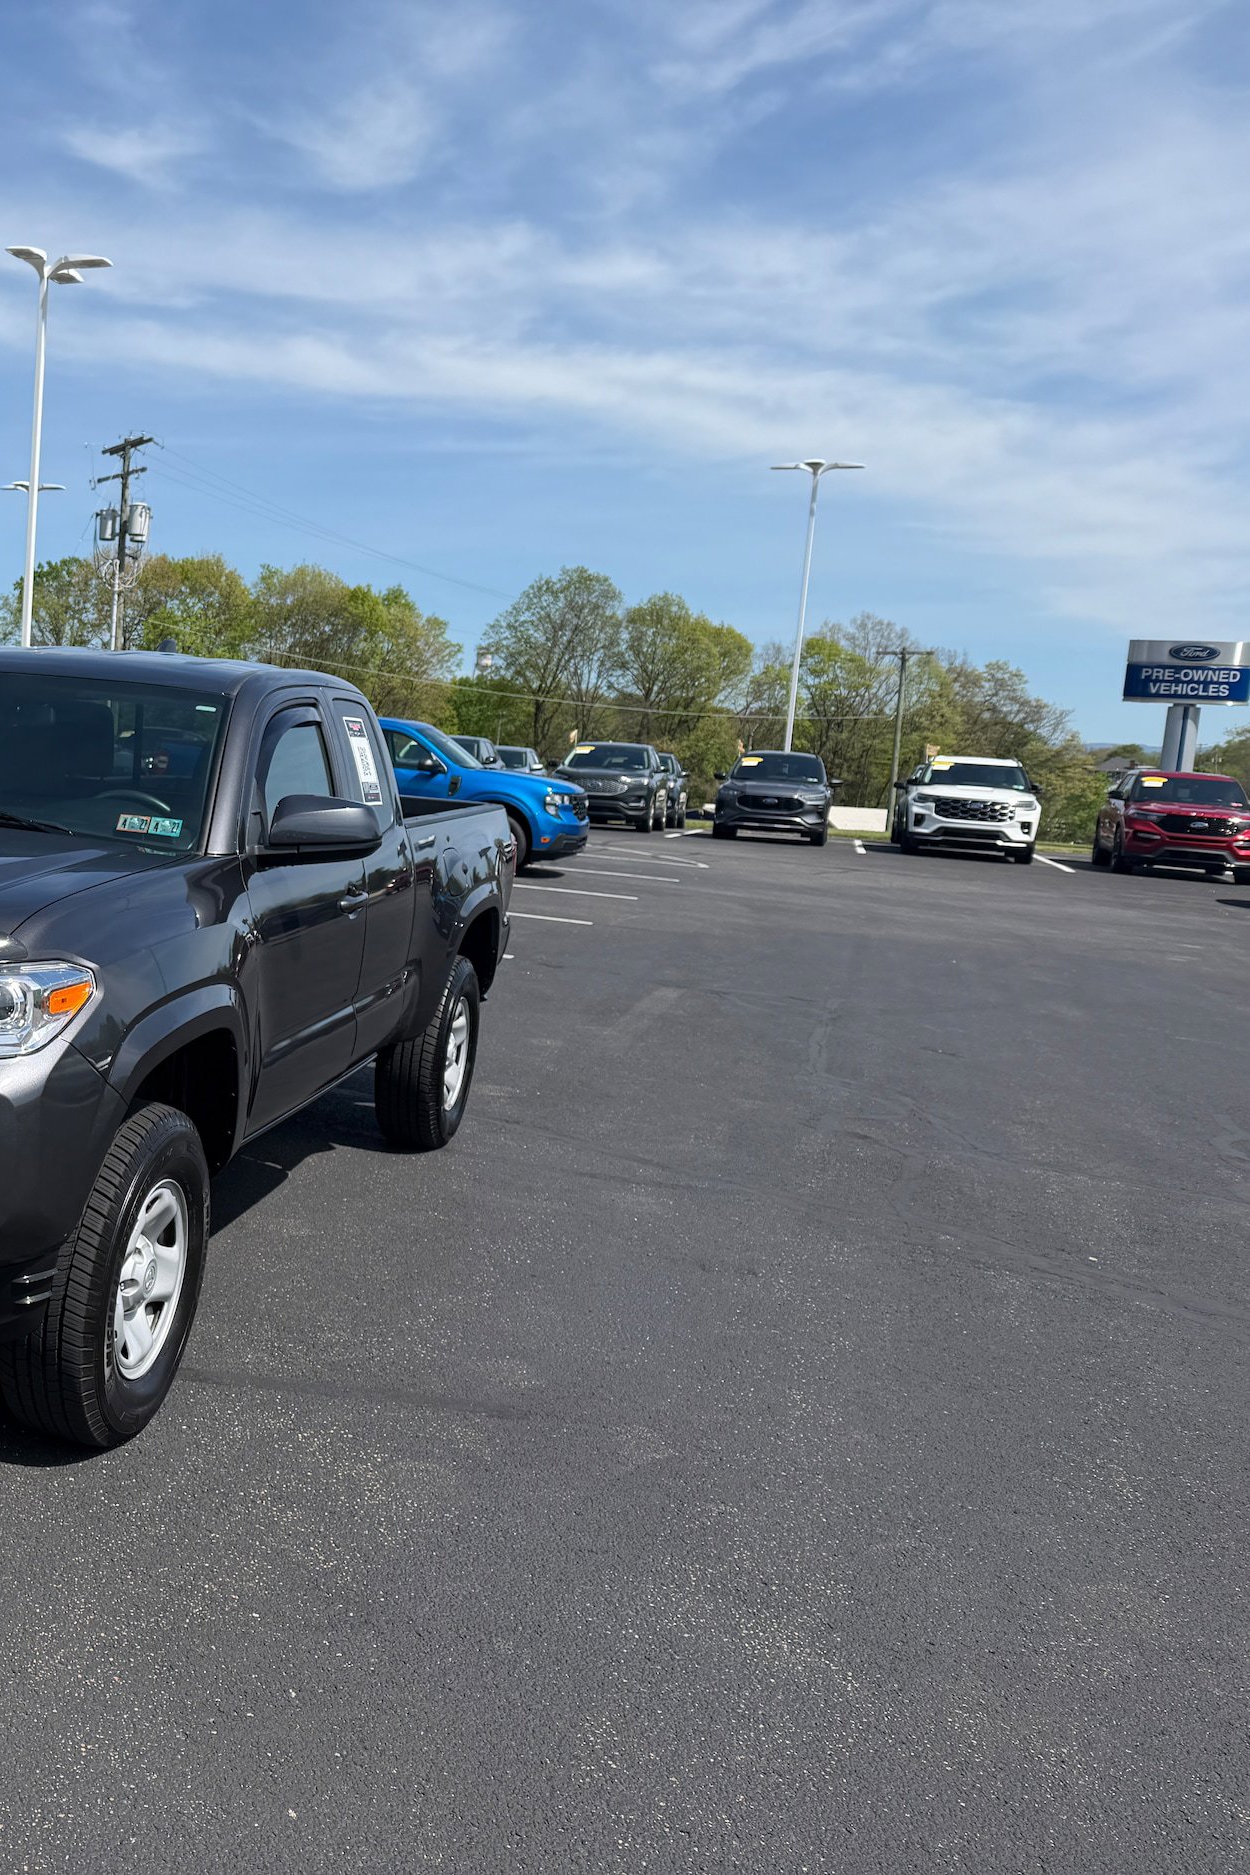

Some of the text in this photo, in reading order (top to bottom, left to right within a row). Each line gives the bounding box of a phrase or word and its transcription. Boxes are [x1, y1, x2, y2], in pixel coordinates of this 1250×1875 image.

[1180, 646, 1210, 657] Ford
[1141, 668, 1240, 682] PRE-OWNED
[1150, 683, 1230, 696] VEHICLES
